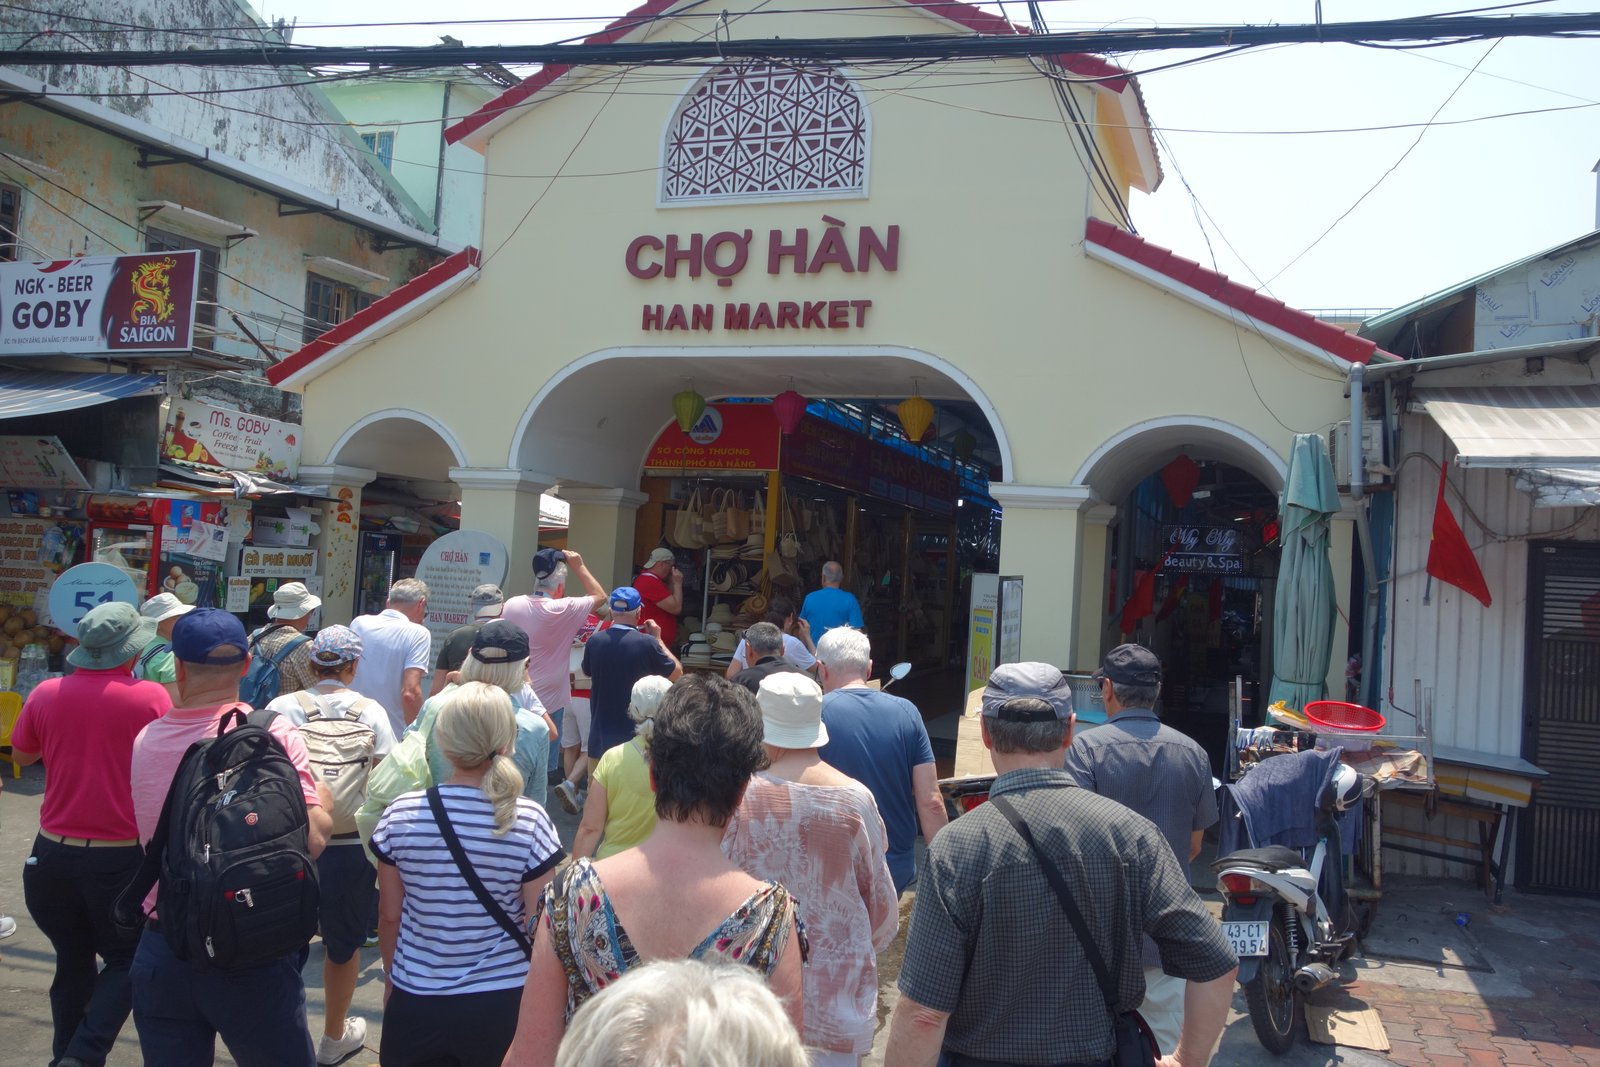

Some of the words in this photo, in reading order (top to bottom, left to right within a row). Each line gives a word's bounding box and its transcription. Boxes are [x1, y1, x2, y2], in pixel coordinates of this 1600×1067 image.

[625, 229, 753, 287] CHỢ
[767, 214, 900, 275] HÀN
[15, 278, 44, 295] NGK
[57, 275, 93, 293] BEER
[12, 299, 91, 330] GOBY
[140, 315, 157, 325] BIA
[641, 303, 714, 331] HAN
[723, 300, 872, 330] MARKET
[120, 326, 176, 342] SAIGON
[210, 410, 232, 428] Ms.
[237, 417, 271, 436] GOBY
[212, 429, 238, 441] Coffee
[244, 436, 262, 446] Fruit
[214, 440, 238, 452] Freeze
[245, 446, 257, 455] Tea
[244, 550, 259, 566] CÀ
[263, 552, 284, 567] PHÊ
[1164, 555, 1205, 570] Beauty
[1207, 556, 1217, 568] &
[1219, 556, 1240, 571] Spa
[430, 612, 442, 622] HAN
[1227, 924, 1260, 938] 43-C1
[1231, 939, 1265, 953] 39.54
